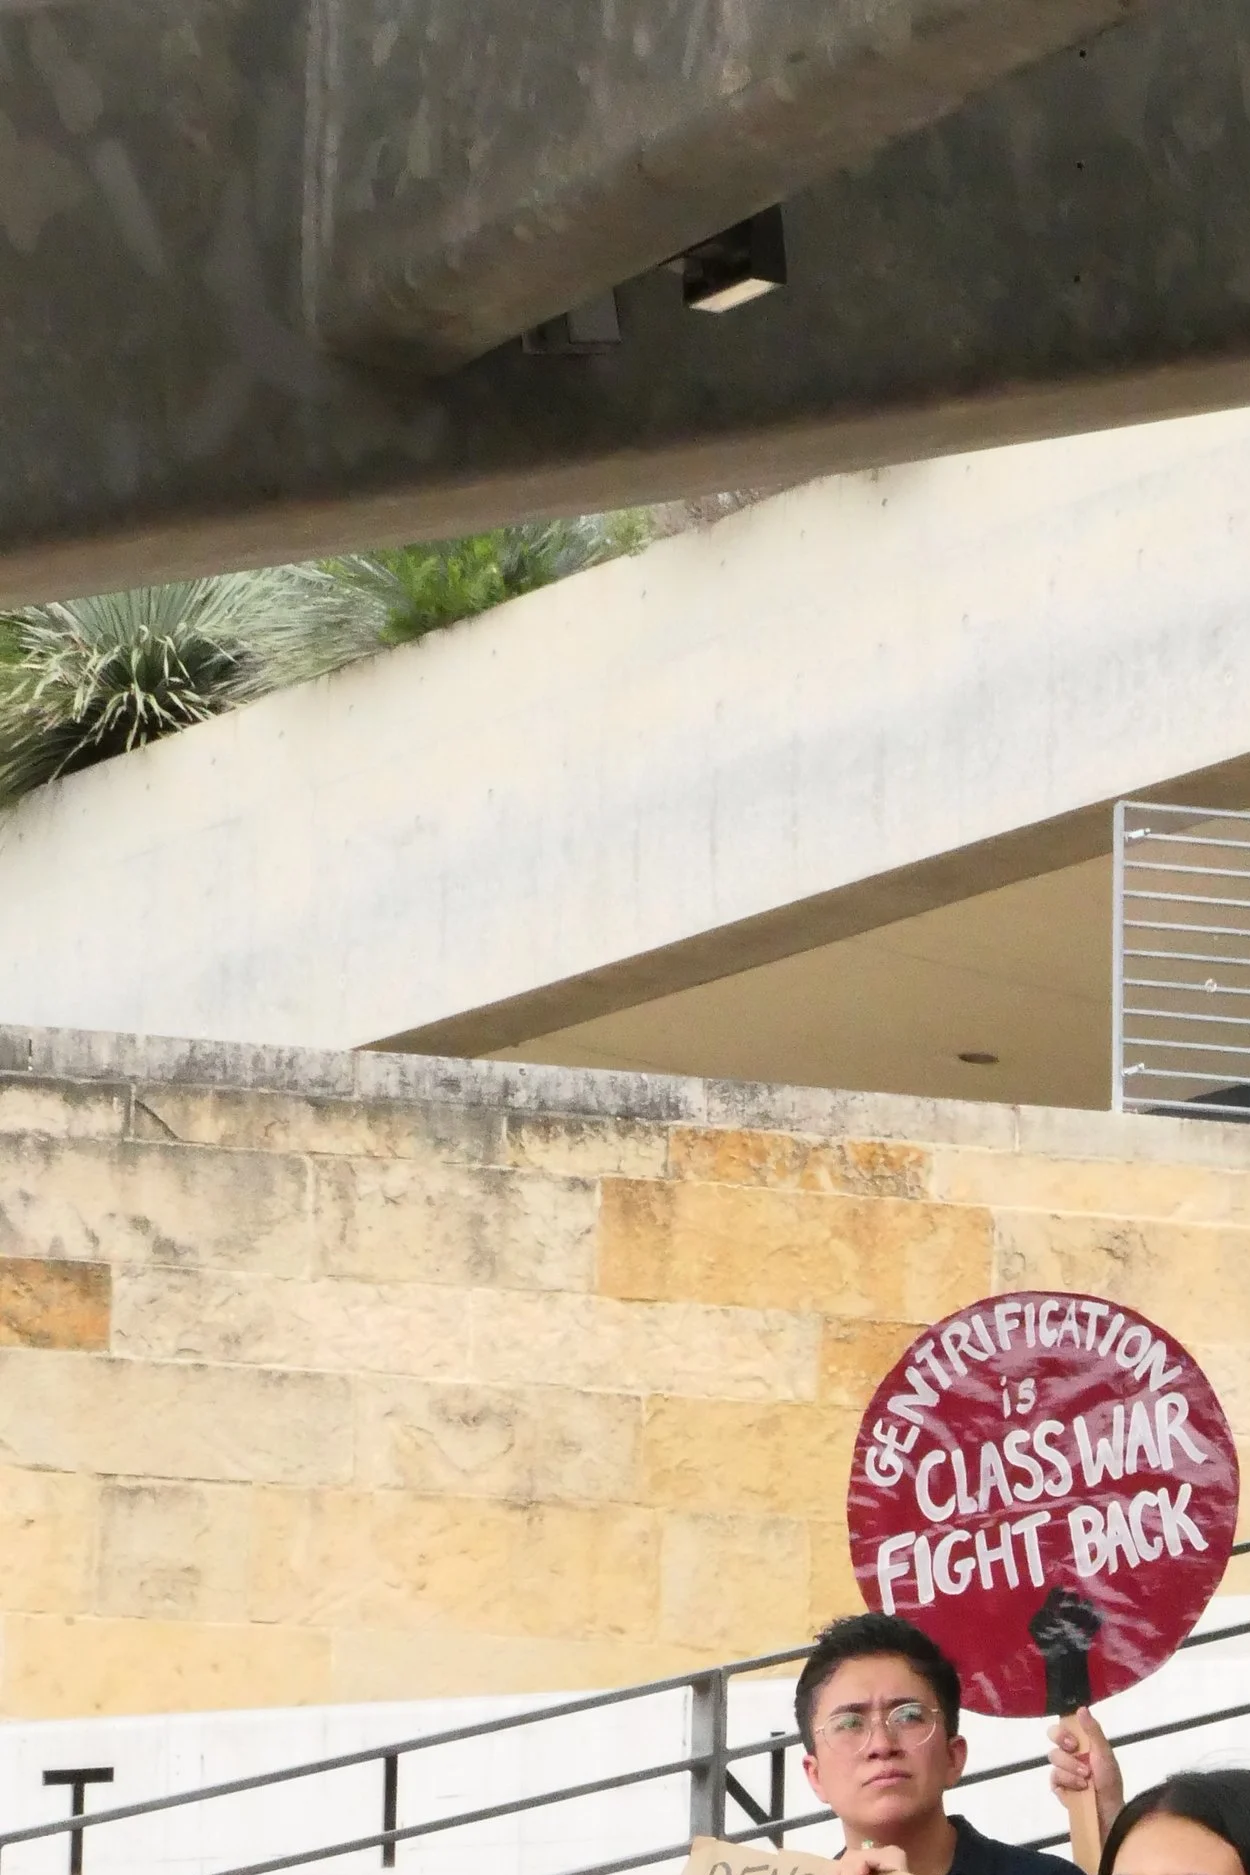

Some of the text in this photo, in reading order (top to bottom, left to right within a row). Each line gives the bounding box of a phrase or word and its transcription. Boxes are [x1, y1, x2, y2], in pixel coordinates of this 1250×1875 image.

[865, 1299, 1182, 1488] GENTRIFICATION
[914, 1391, 1208, 1522] CLASS WAR
[876, 1482, 1210, 1616] FIGHT BACK
